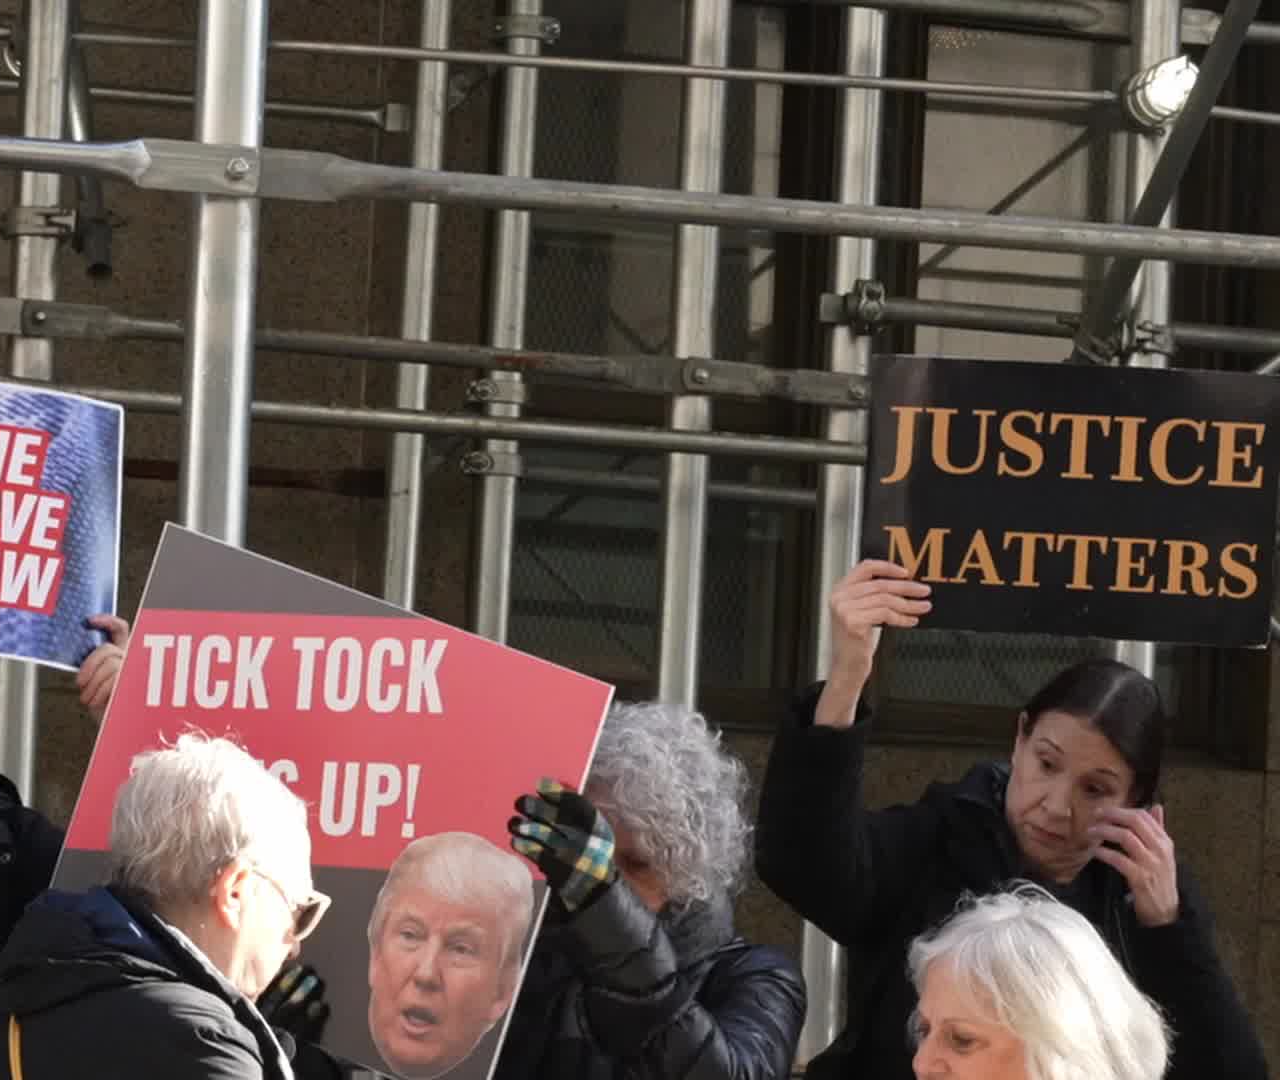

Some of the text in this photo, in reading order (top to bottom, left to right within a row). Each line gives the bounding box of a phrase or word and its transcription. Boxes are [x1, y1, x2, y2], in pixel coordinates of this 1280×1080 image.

[880, 406, 1266, 489] JUSTICE
[883, 525, 1259, 599] MATTERS
[143, 634, 449, 713] TICK TOCK
[318, 762, 422, 837] UP!
